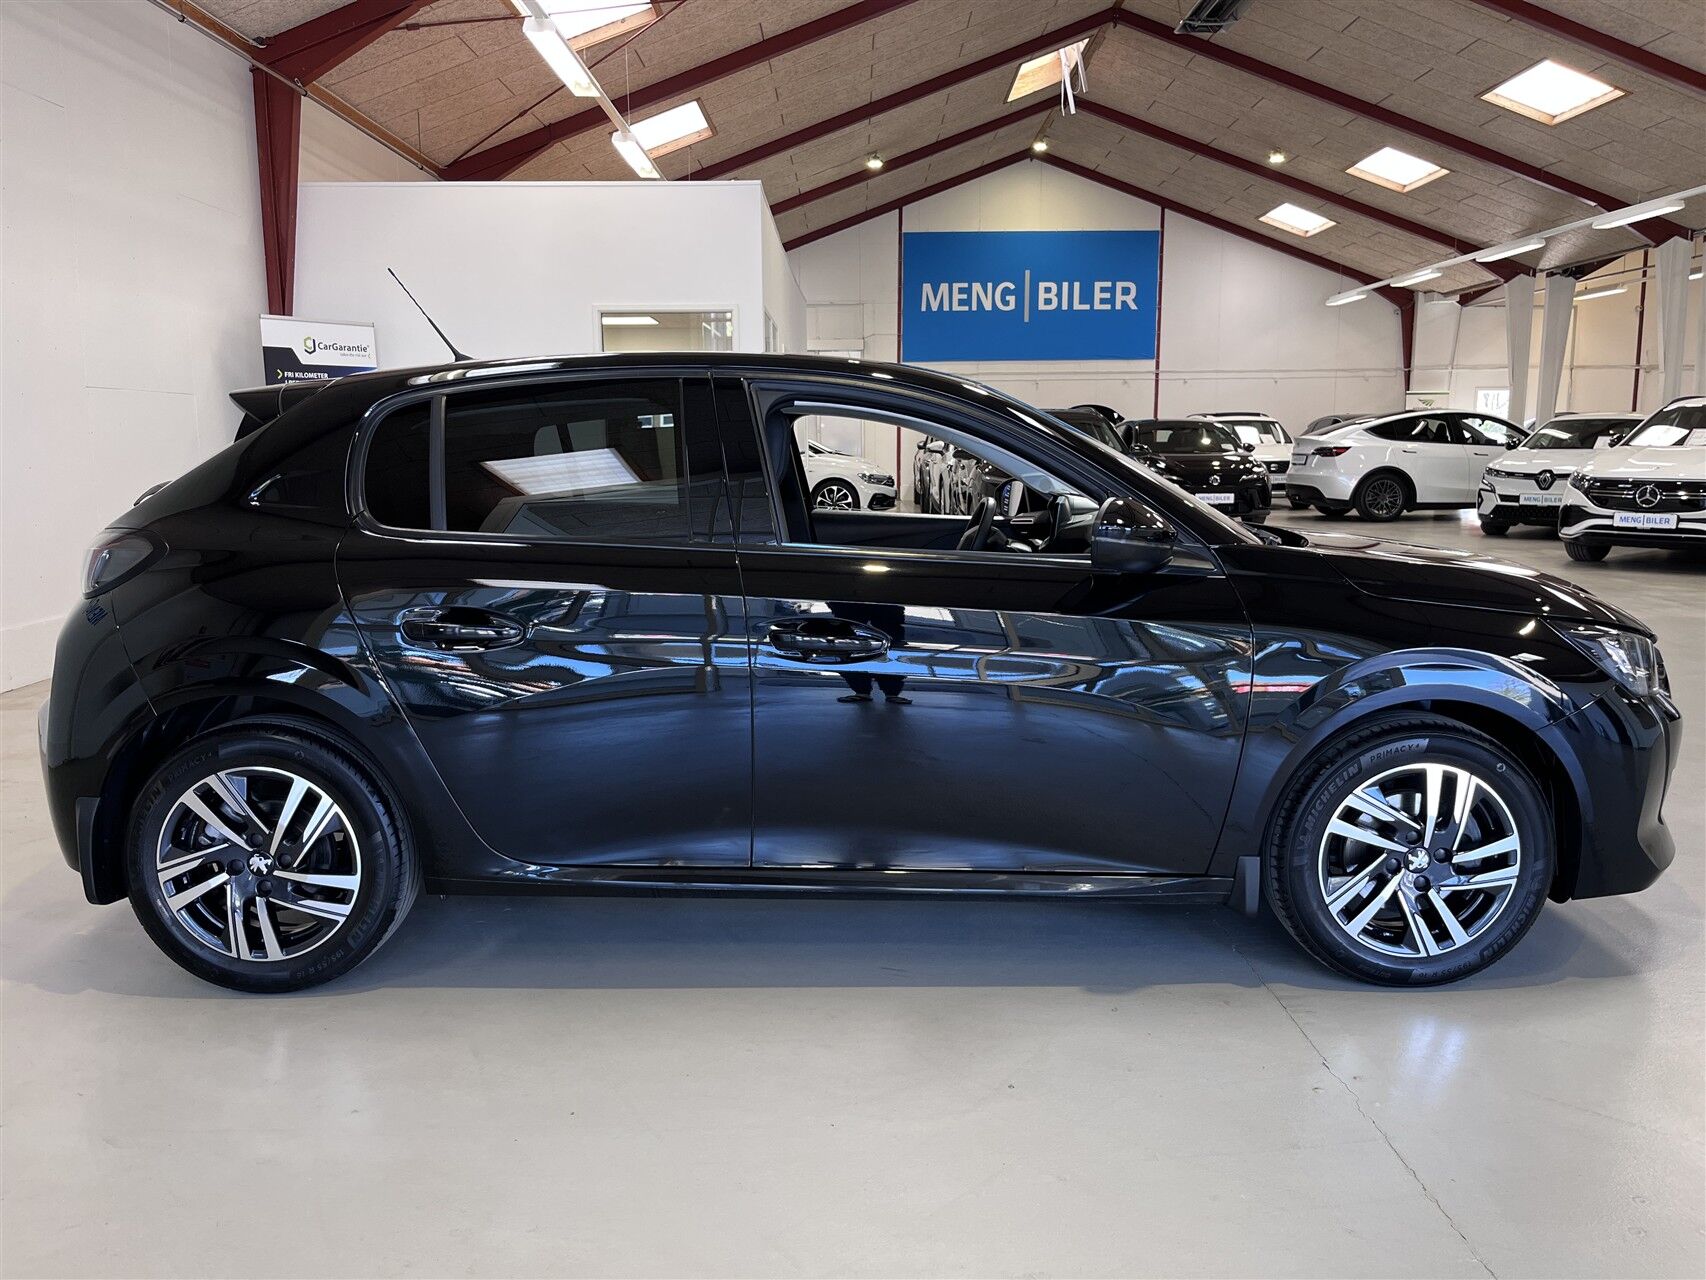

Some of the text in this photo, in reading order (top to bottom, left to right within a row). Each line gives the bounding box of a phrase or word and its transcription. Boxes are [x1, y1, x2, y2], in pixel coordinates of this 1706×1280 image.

[921, 281, 1138, 312] MENG BILER
[317, 341, 368, 353] CarGarantie
[295, 371, 329, 379] KILOMETER
[1523, 495, 1562, 504] MENG BILER
[1619, 515, 1671, 525] MENG BILER
[1370, 744, 1414, 762] PRIMACY
[1304, 762, 1360, 832] MICHELIN
